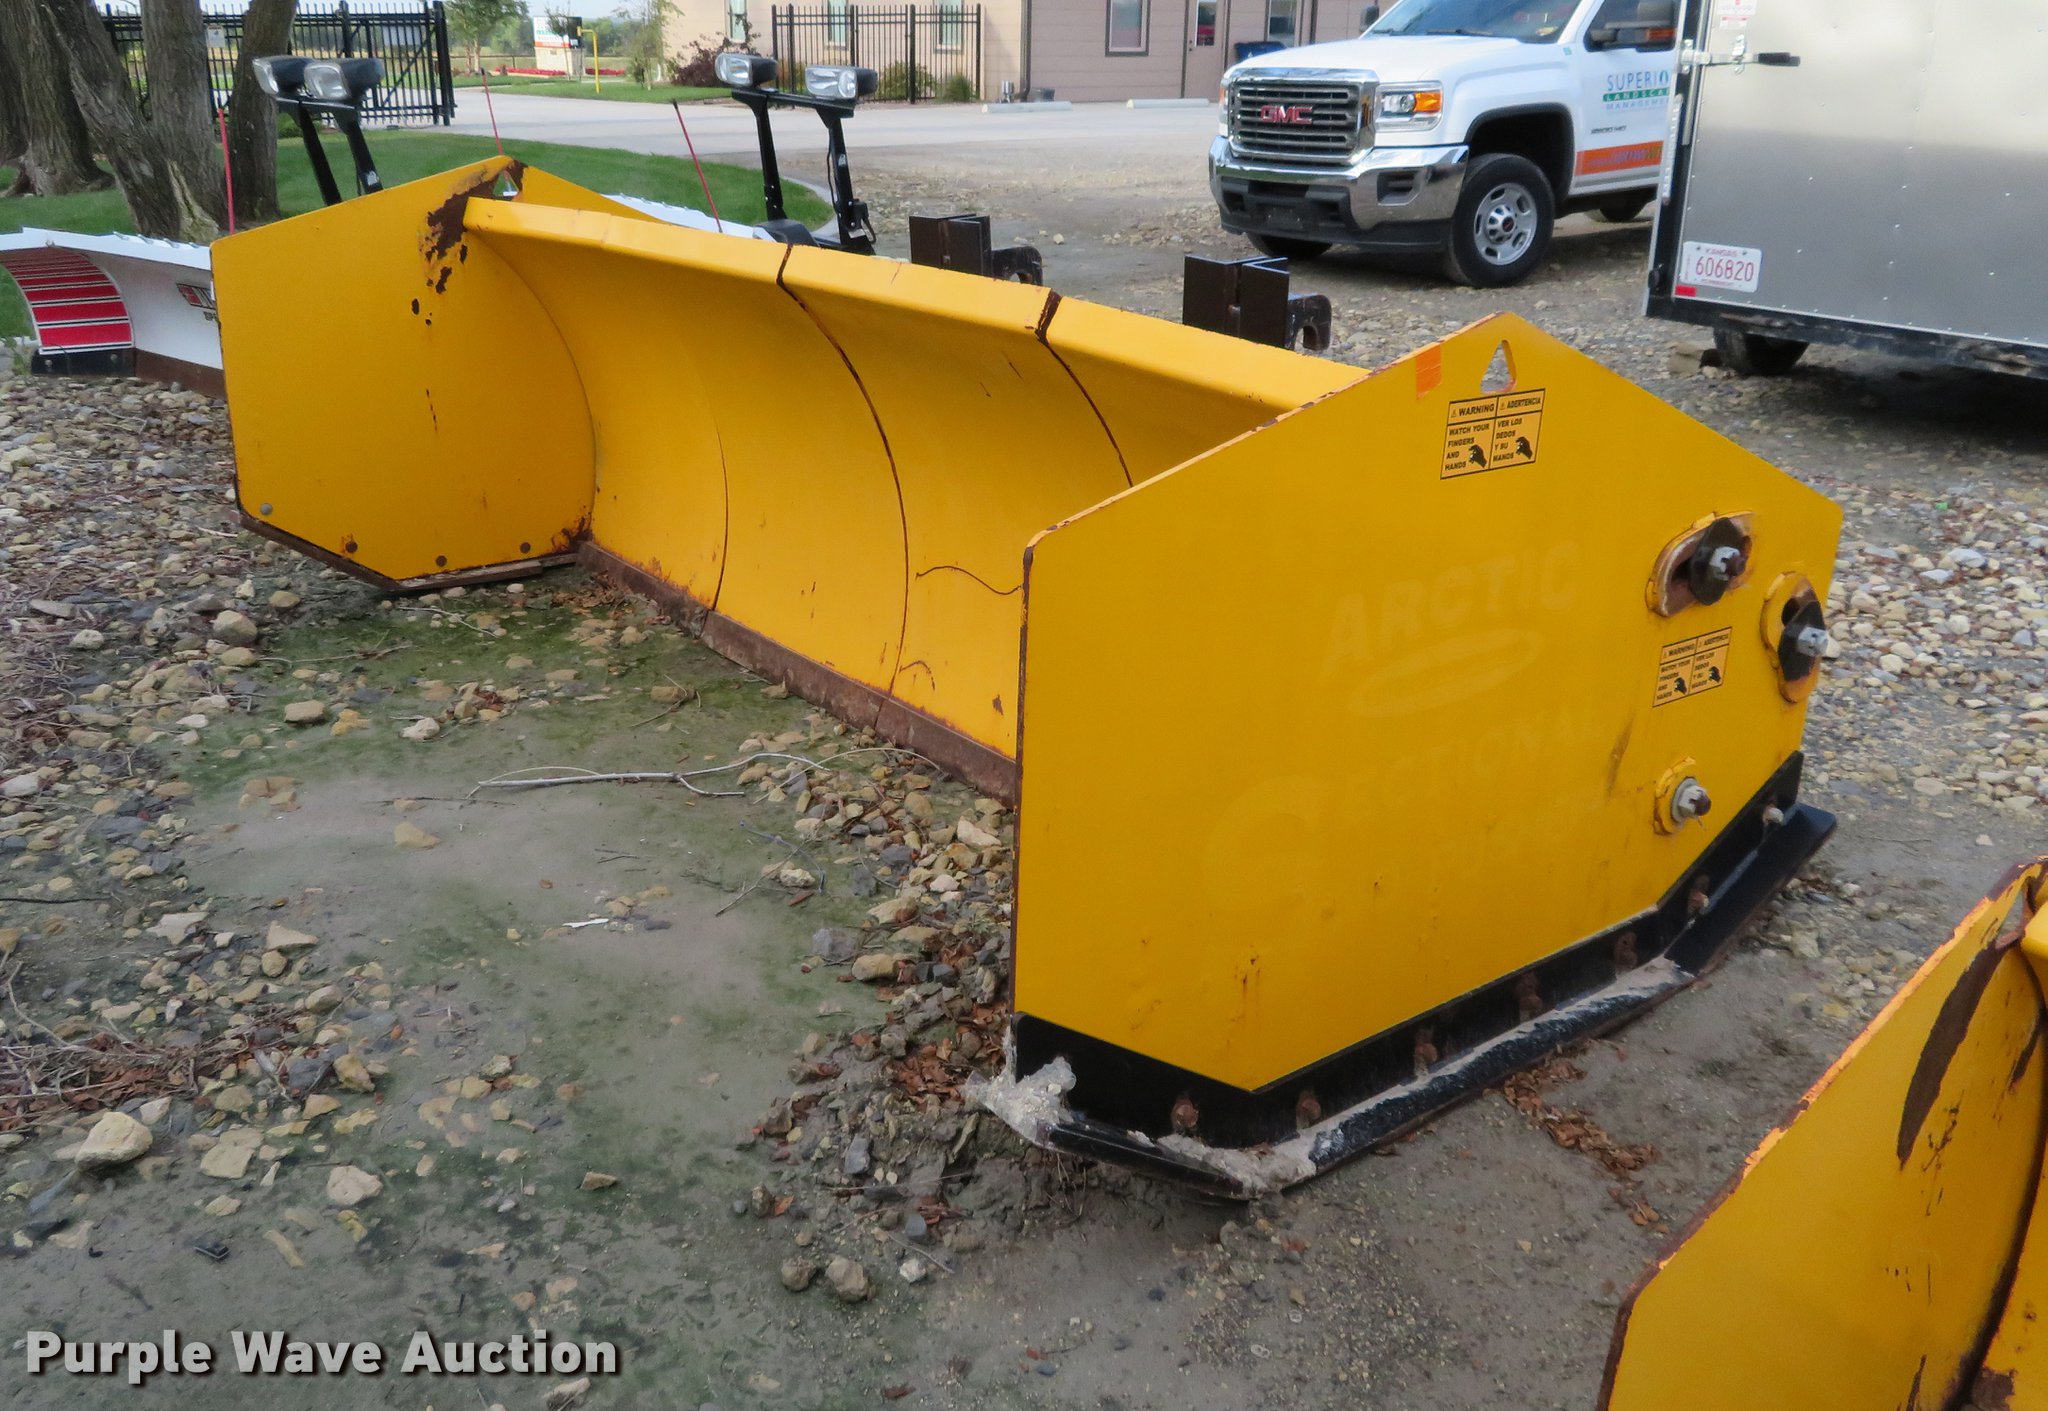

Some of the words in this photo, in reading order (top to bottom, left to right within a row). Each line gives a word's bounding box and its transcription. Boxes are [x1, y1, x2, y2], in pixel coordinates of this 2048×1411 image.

[1260, 104, 1313, 124] GMC
[1695, 256, 1754, 282] 606820
[1458, 403, 1495, 417] WARNING
[1497, 419, 1510, 428] VER
[1510, 417, 1523, 426] LOS
[1449, 426, 1471, 436] WATCH
[1473, 423, 1490, 433] YOUR
[1447, 437, 1475, 448] FINGERS
[1446, 451, 1460, 459] AND
[1492, 452, 1514, 462] MANOS
[1444, 461, 1467, 471] HANDS
[1314, 540, 1582, 686] ARCTIC
